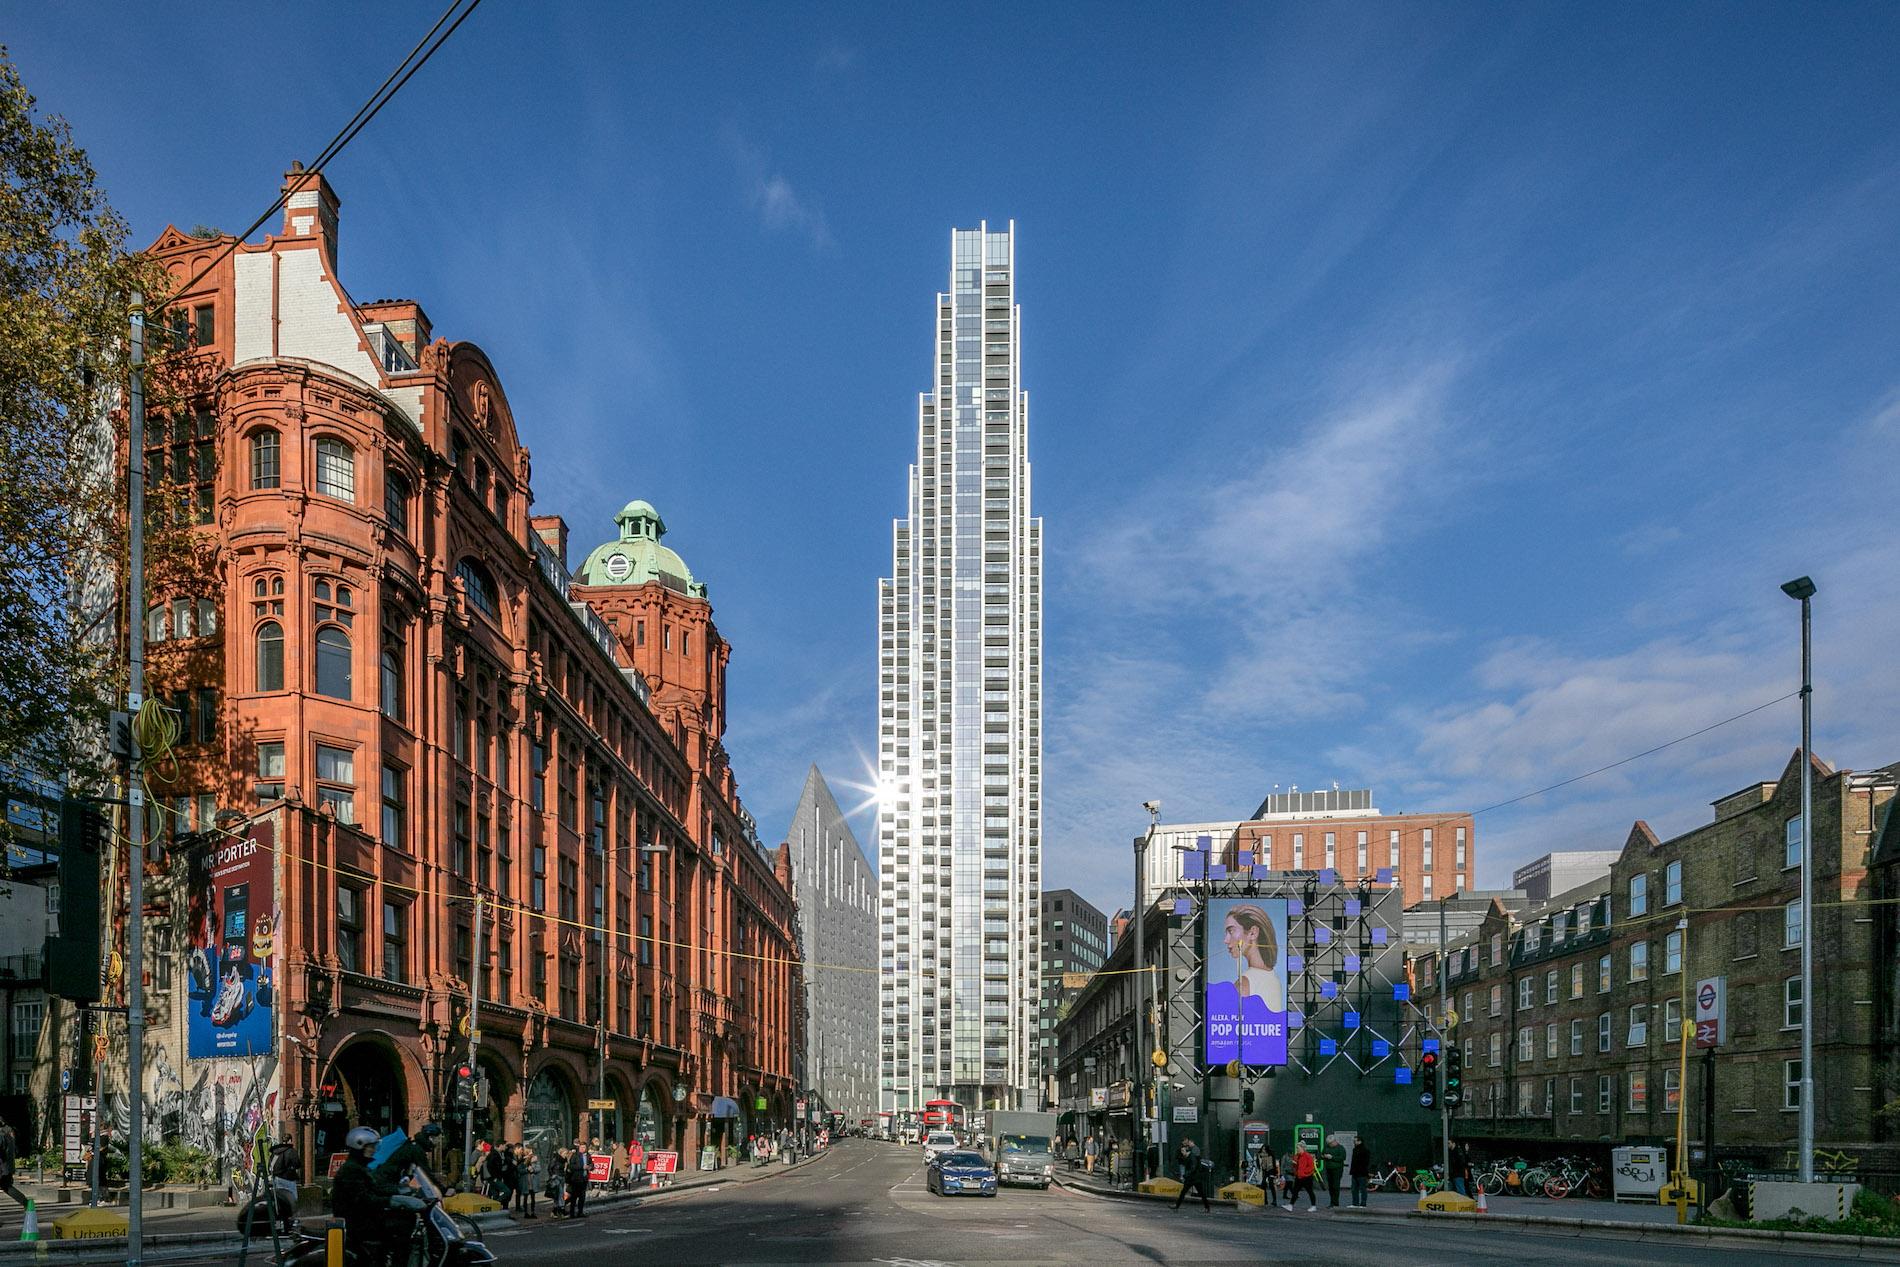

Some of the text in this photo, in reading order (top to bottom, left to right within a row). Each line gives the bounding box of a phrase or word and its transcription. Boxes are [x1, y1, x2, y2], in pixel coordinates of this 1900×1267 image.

[201, 838, 257, 871] MR PORTER
[1211, 1023, 1282, 1036] POP CULTURE
[74, 1228, 126, 1239] Urban64
